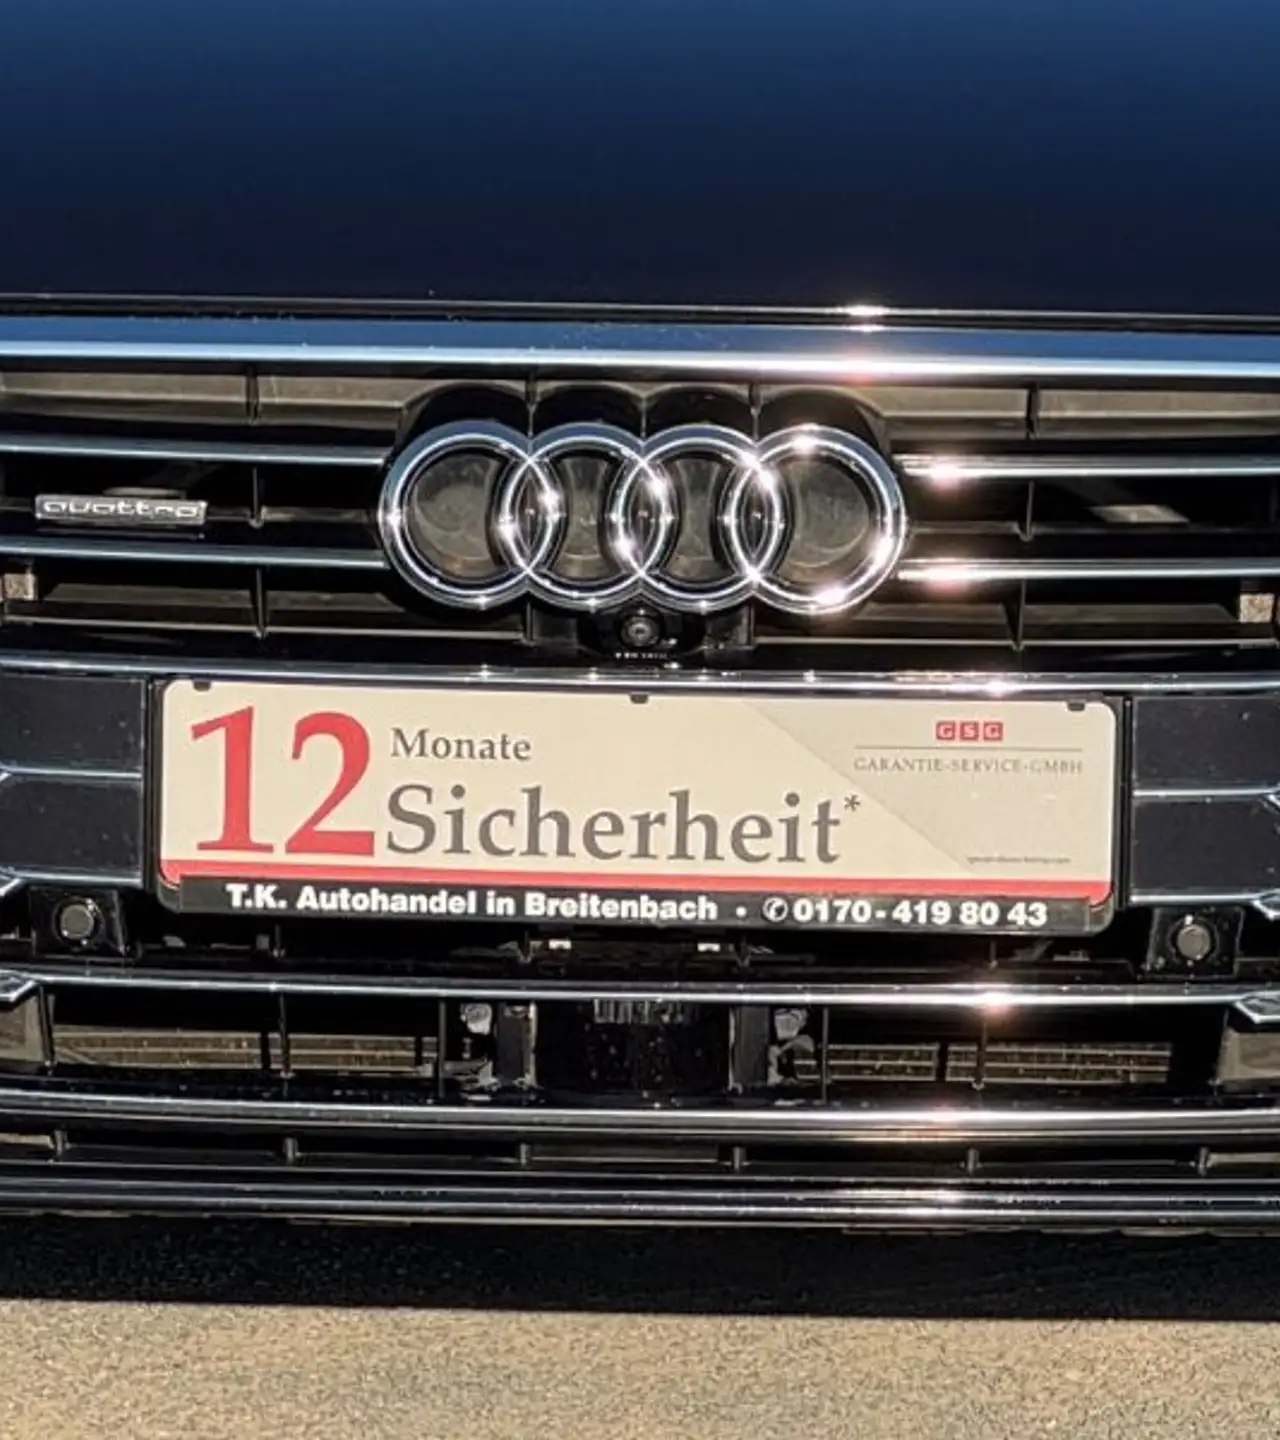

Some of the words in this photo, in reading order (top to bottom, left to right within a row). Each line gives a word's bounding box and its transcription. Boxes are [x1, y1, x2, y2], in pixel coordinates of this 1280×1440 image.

[43, 500, 200, 518] quattro
[390, 726, 532, 760] Monate
[190, 705, 376, 858] 12
[225, 882, 288, 910] T.K.
[296, 885, 477, 914] Autohandel
[486, 890, 516, 916] in
[524, 892, 719, 921] Breitenbach
[959, 901, 1000, 926] 80
[1007, 901, 1048, 927] 43
